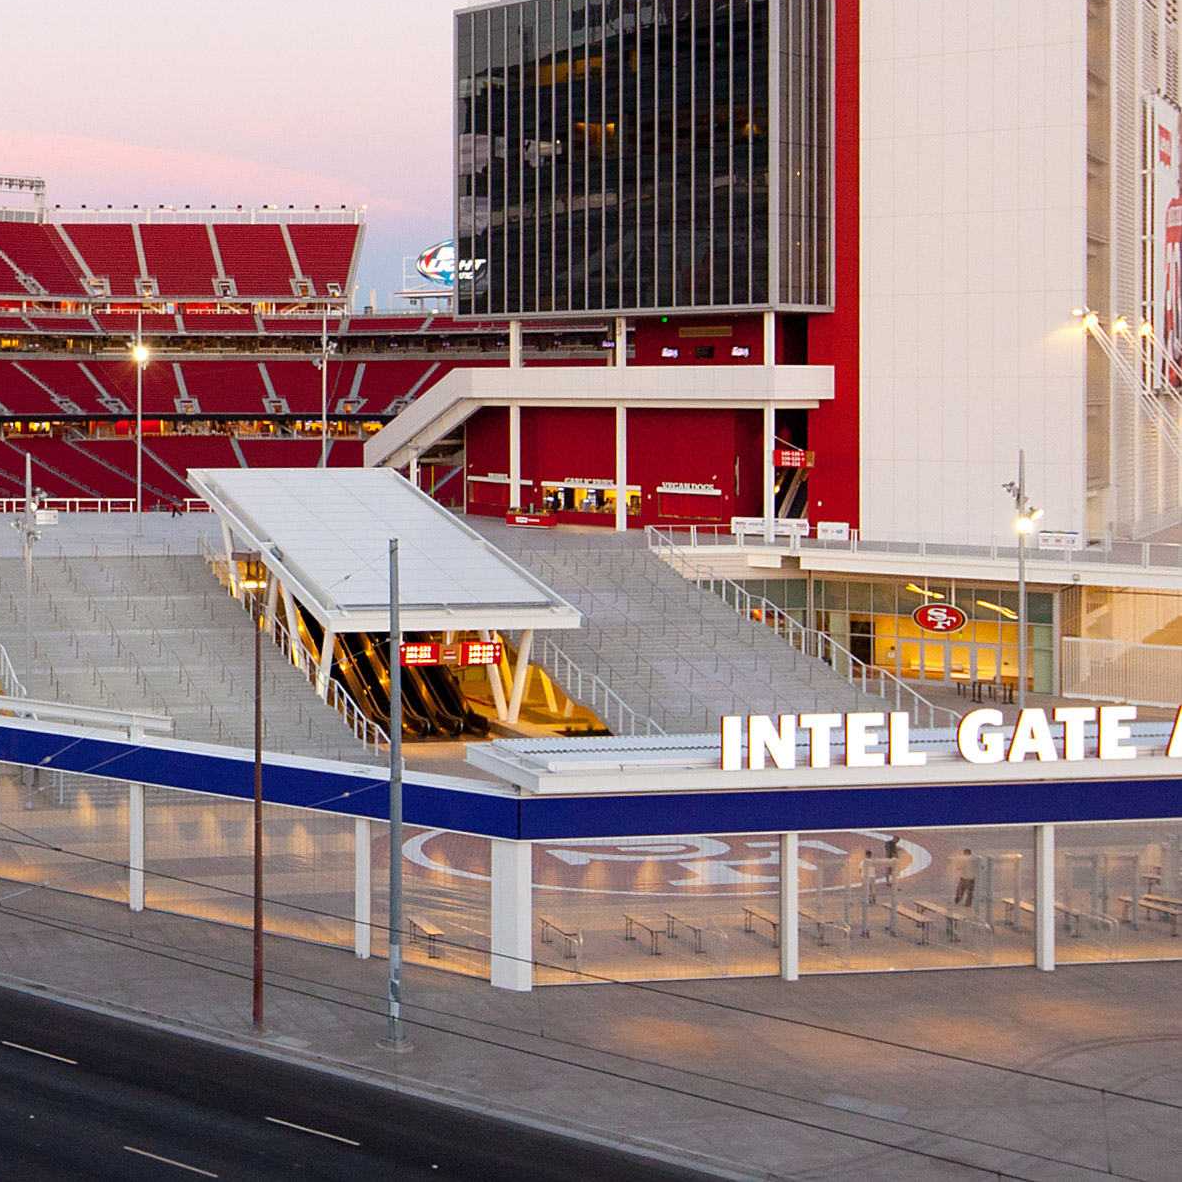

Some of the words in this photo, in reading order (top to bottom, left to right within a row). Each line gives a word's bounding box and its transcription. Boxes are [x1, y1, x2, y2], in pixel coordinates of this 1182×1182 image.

[661, 482, 690, 490] VEGAN
[691, 483, 715, 491] DOGS
[721, 711, 927, 771] INTEL
[958, 705, 1137, 764] GATE
